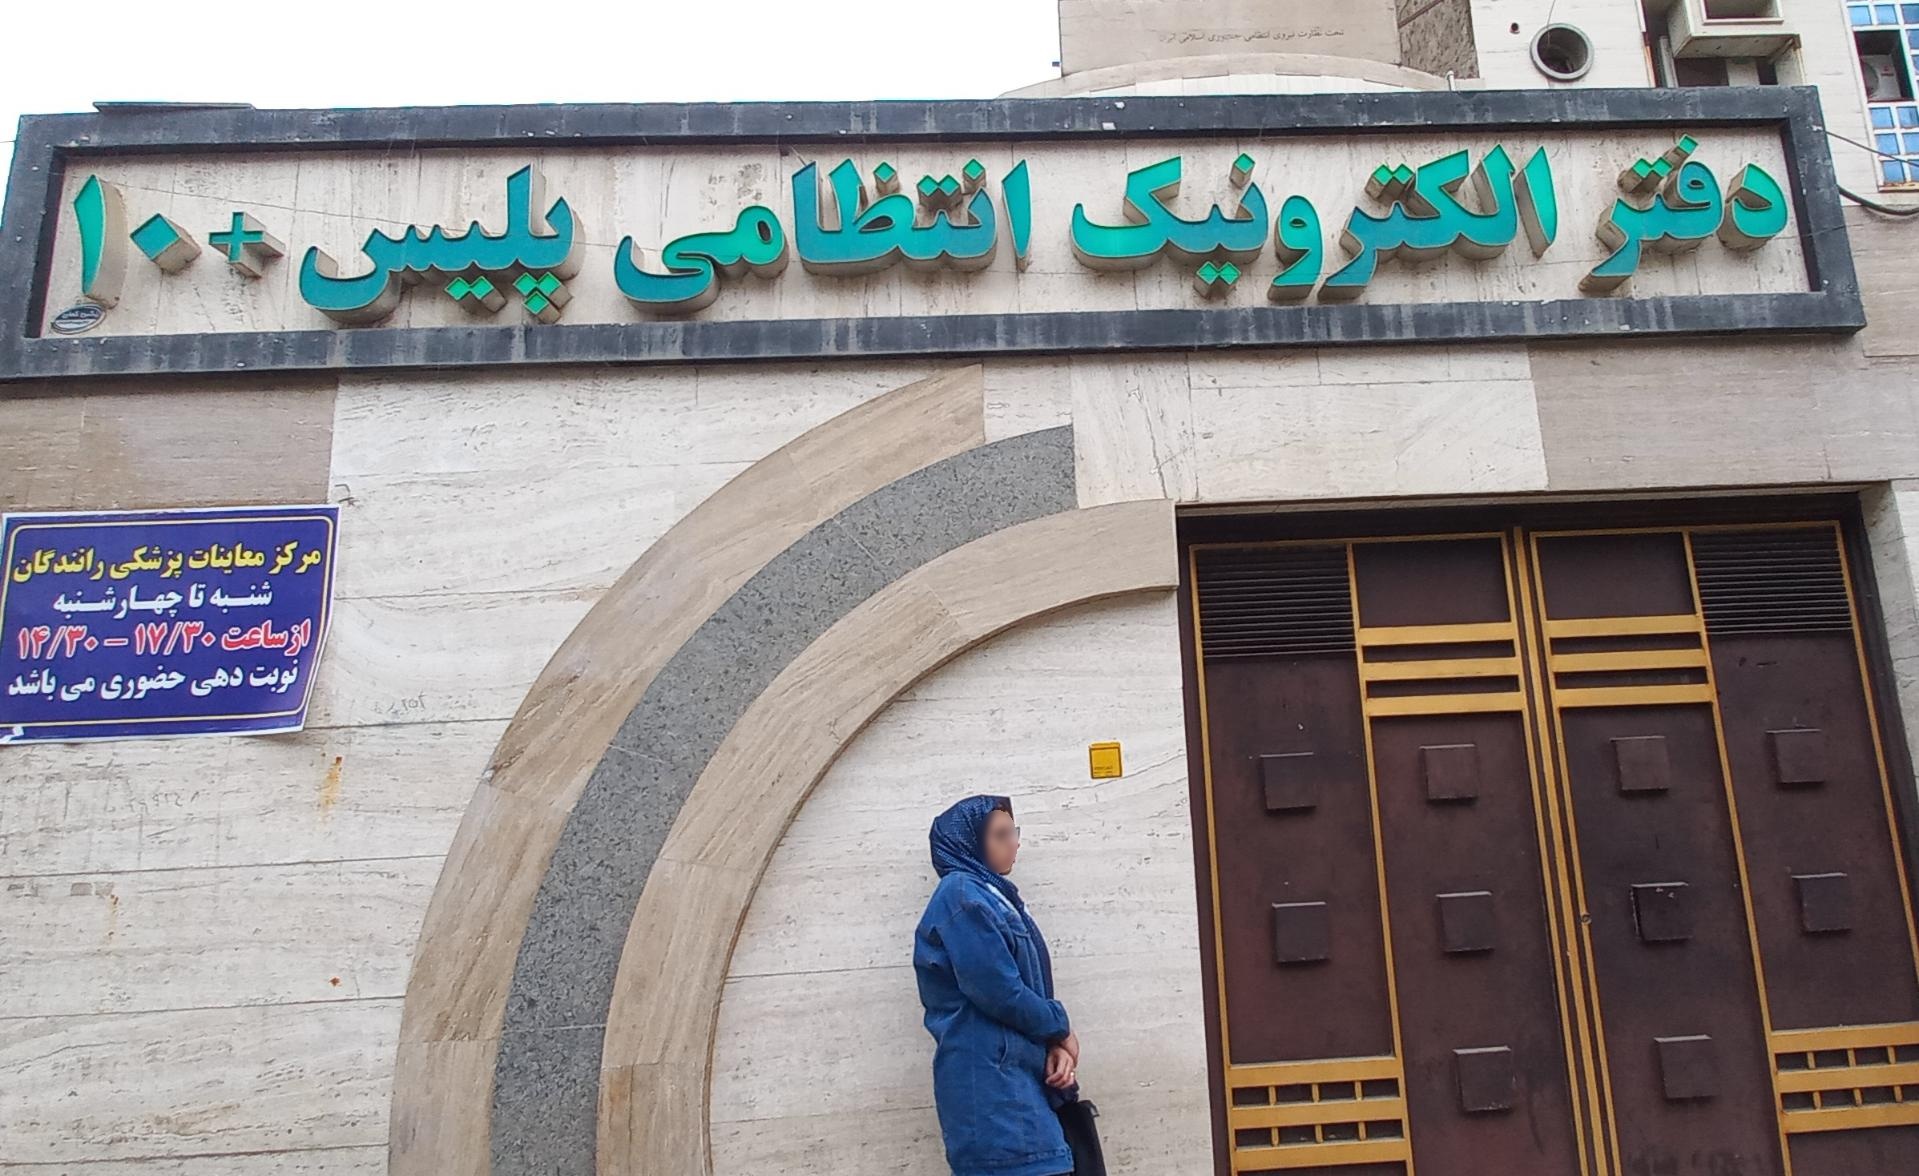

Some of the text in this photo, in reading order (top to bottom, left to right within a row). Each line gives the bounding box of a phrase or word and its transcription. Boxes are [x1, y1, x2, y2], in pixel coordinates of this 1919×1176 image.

[299, 163, 574, 314] پلیس
[613, 157, 1033, 303] انتظامی
[1071, 143, 1560, 288] الکترونیک
[1591, 134, 1789, 277] دفتر
[13, 541, 321, 582] مرکز معاینات پزشکی رانندگان
[53, 581, 273, 619] شنبه تا چهارشنبه
[8, 659, 298, 702] نوبت دهی حضوری می باشد
